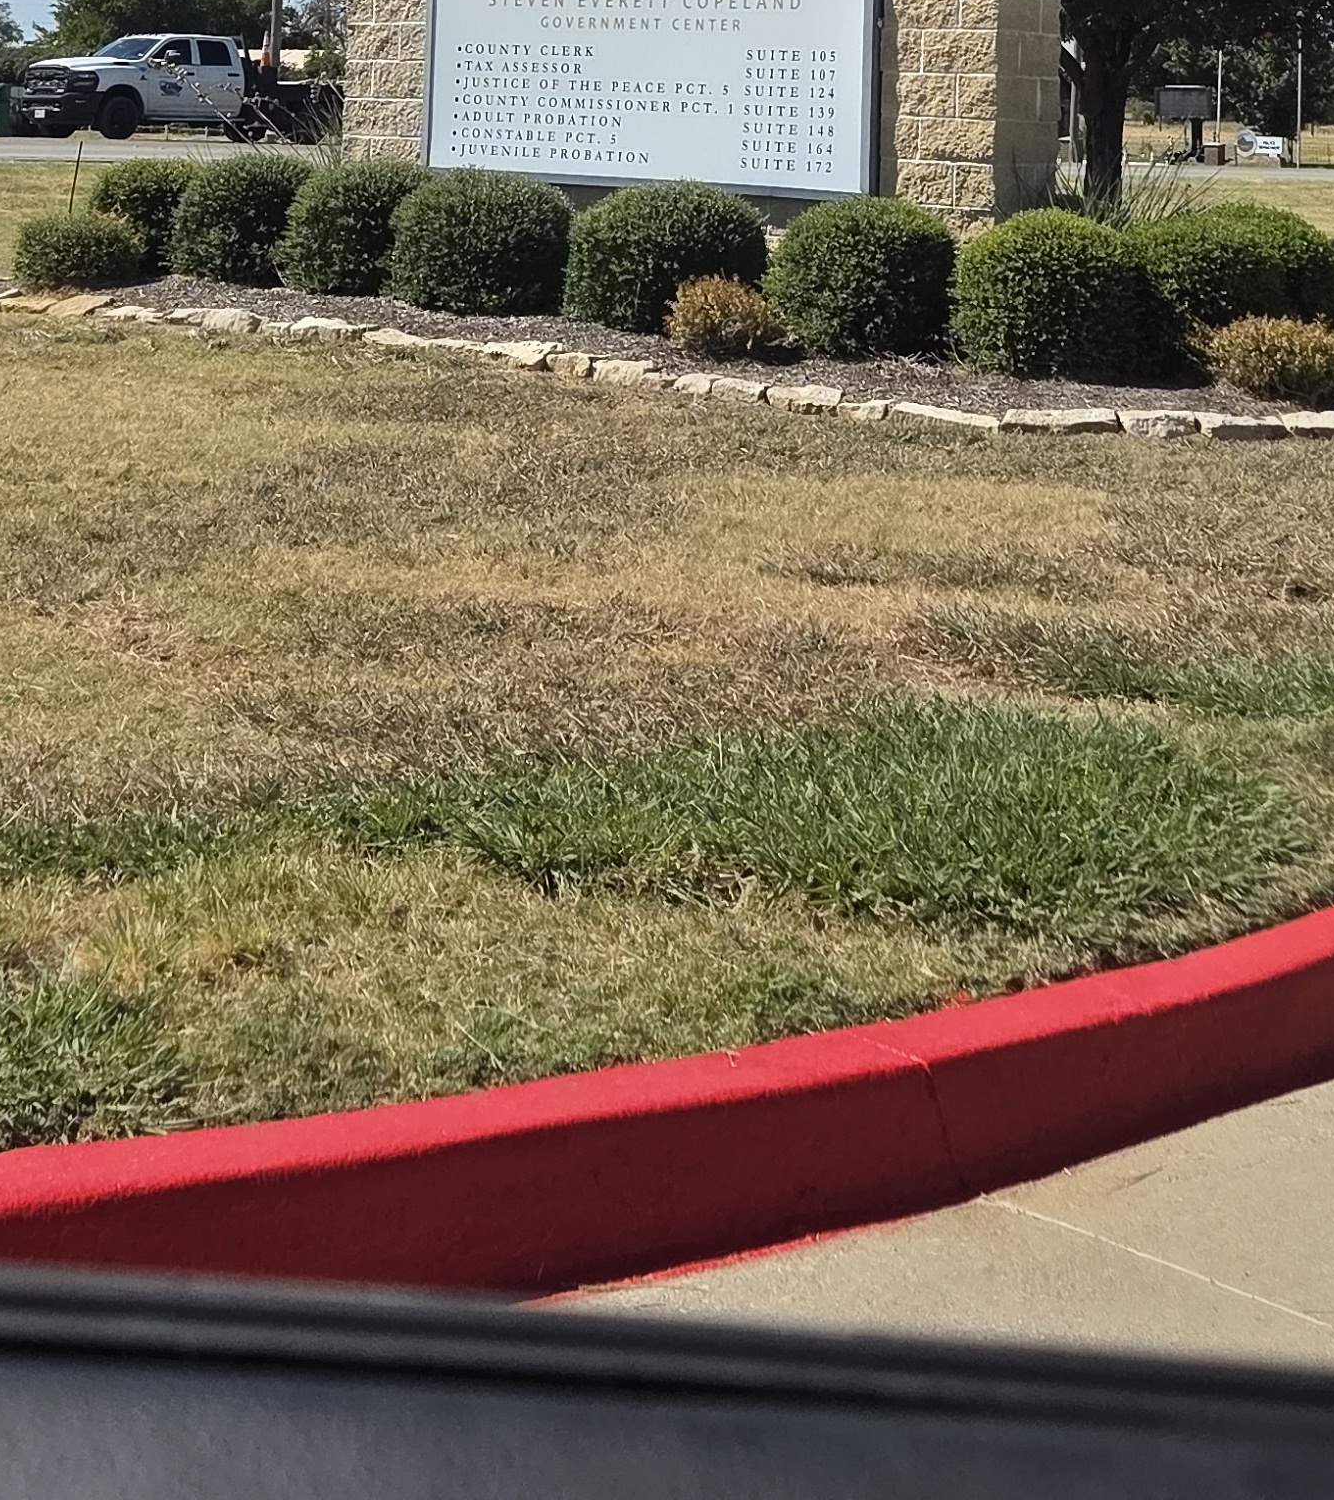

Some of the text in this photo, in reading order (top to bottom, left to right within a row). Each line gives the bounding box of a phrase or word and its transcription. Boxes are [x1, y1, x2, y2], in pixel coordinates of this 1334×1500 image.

[540, 16, 742, 32] GOVERNMENT CENTER
[464, 43, 595, 57] COUNTY CLERK
[746, 49, 836, 62] SUITE 105
[464, 60, 583, 75] TAX ASSESSOR
[745, 67, 835, 81] SUITE 107
[462, 77, 729, 96] JUSTICE OF THE PEACE PCT. 5
[744, 85, 835, 99] SUITE 124
[462, 94, 734, 115] COUNTY COMMISSIONER PCT. 1
[743, 104, 835, 119] SUITE 139
[461, 110, 622, 128] ADULT PROBATION
[461, 127, 617, 145] CONSTABLE PCT. 5
[742, 122, 834, 137] SUITE 148
[459, 143, 649, 164] JUVENILE PROBATION
[741, 139, 833, 155] SUITE 164
[740, 157, 832, 173] SUITE 172
